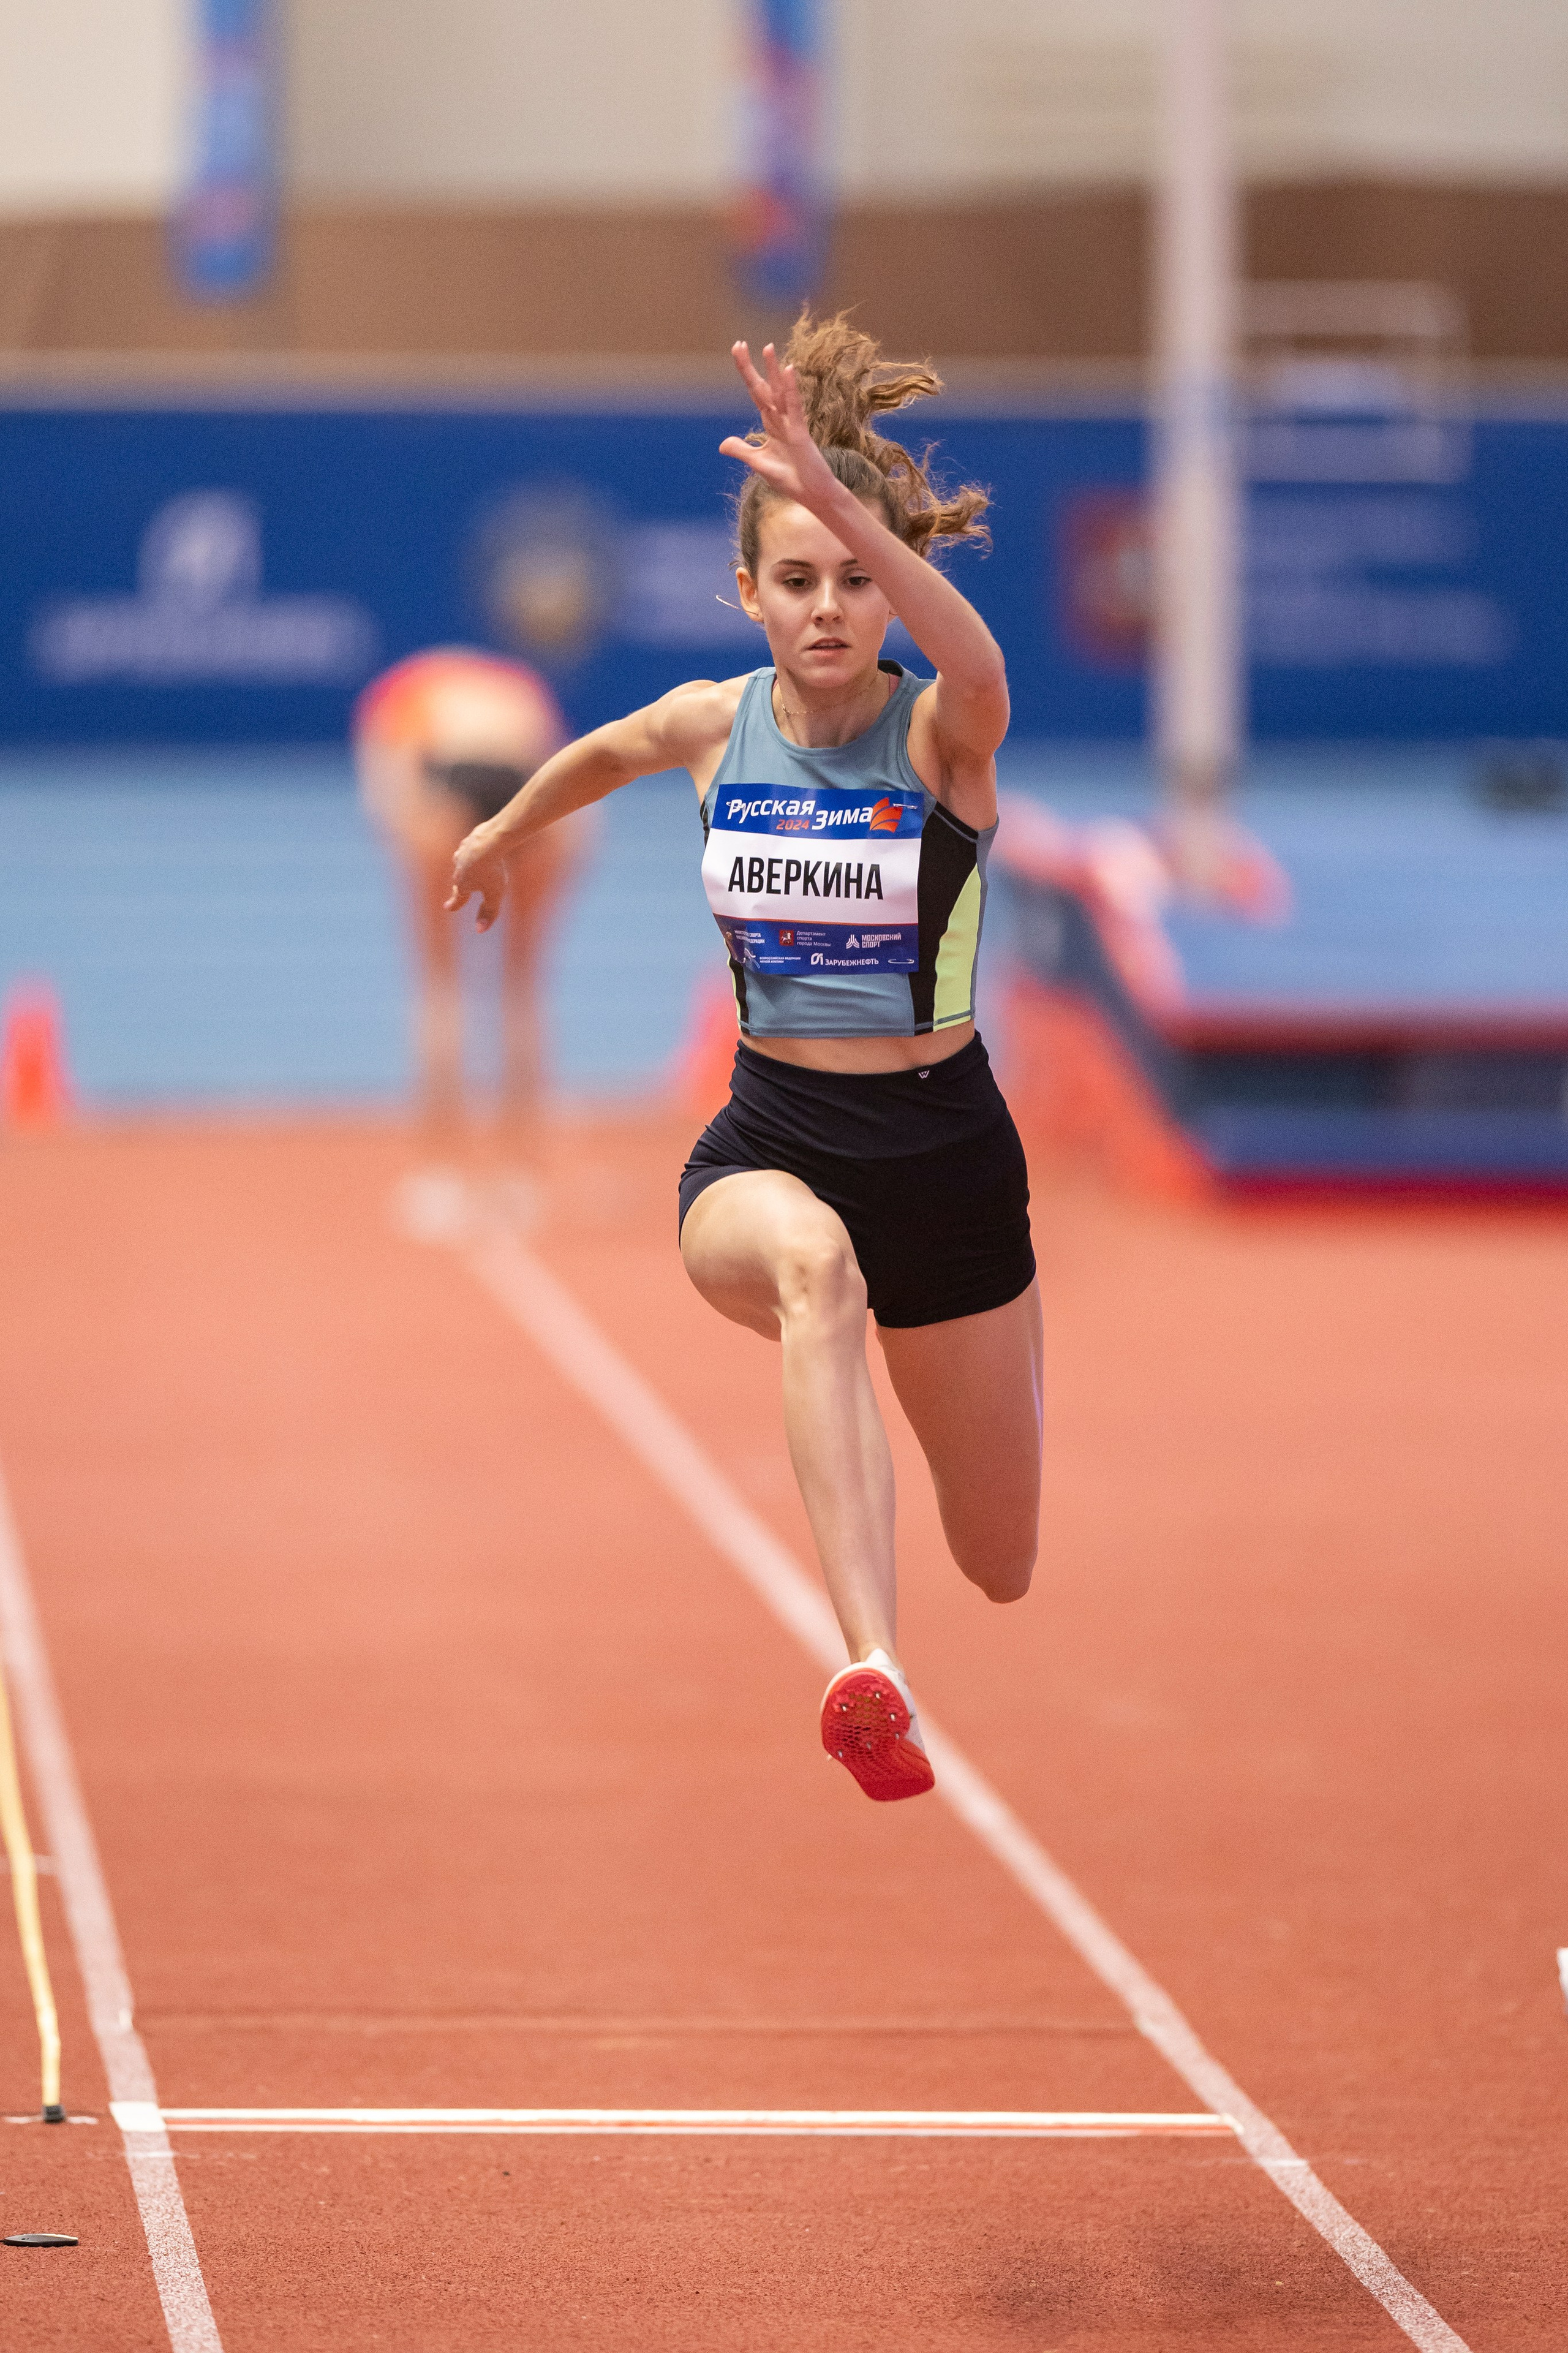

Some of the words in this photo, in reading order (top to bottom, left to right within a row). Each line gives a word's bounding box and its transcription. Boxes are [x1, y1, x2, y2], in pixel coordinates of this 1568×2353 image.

[728, 799, 816, 824] Русская
[812, 807, 873, 830] Зима
[776, 819, 810, 830] 2024
[728, 856, 884, 900] АВЕРКИНА
[861, 932, 902, 942] МОСКОВСКИЙ
[824, 958, 880, 967] ЗАРУБЕЖНЕФТЬ
